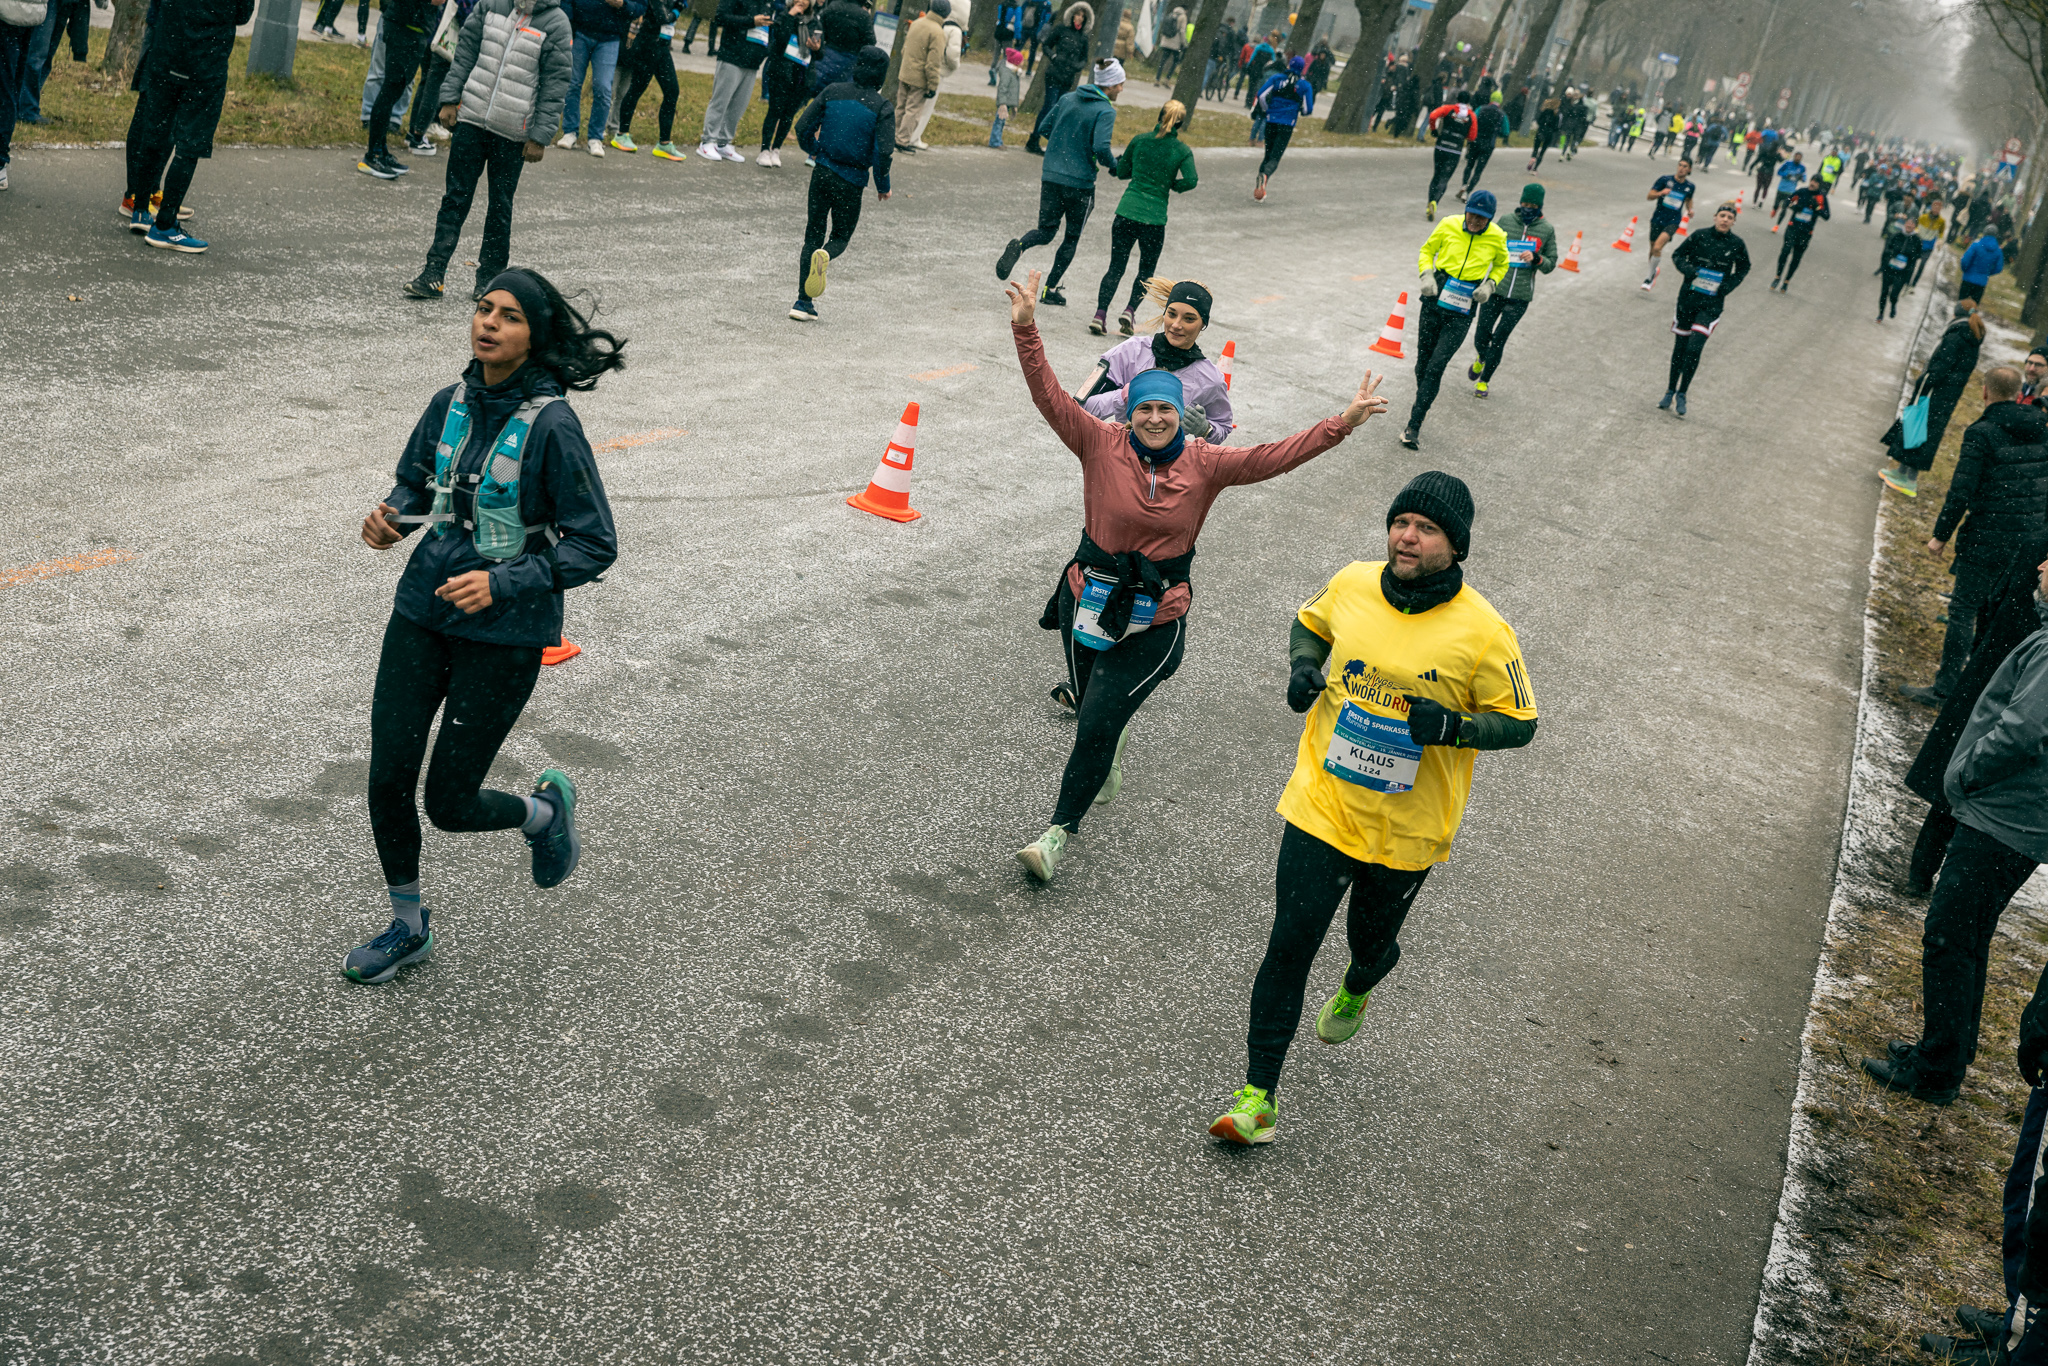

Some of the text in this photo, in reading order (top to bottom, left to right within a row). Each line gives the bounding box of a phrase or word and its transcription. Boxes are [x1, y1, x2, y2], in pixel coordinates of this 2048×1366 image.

[1091, 586, 1108, 596] ERSTE
[1364, 672, 1393, 688] WINGS
[1366, 680, 1383, 690] LIFE
[1351, 681, 1410, 713] WORLD RU
[1345, 715, 1369, 732] Running
[1347, 710, 1410, 736] ERSTE SPARKASSE
[1349, 746, 1395, 768] KLAUS
[1357, 763, 1381, 776] 1124
